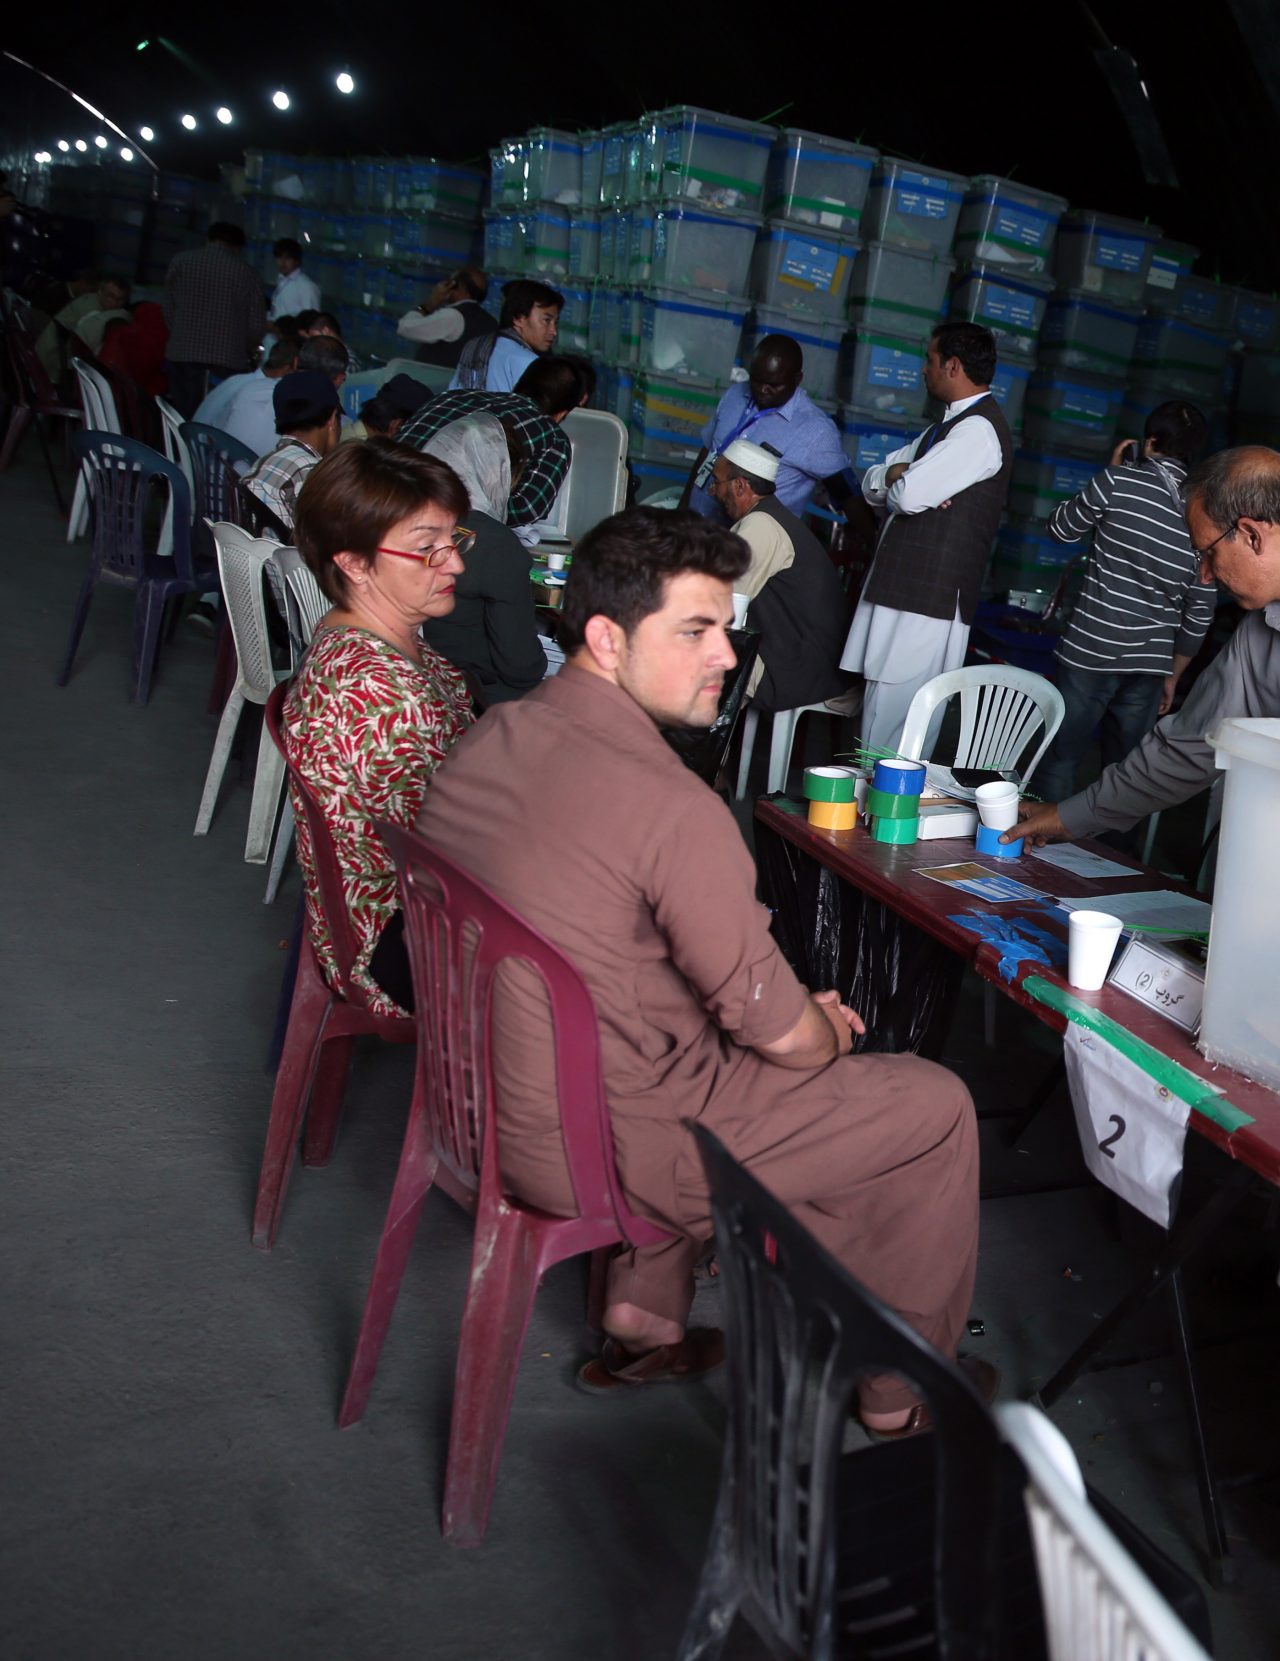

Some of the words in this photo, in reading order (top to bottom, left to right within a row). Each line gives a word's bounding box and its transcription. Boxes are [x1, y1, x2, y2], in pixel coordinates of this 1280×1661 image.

[1135, 971, 1153, 992] (2)
[1155, 986, 1184, 1007] گروپ
[1098, 1114, 1126, 1159] 2
